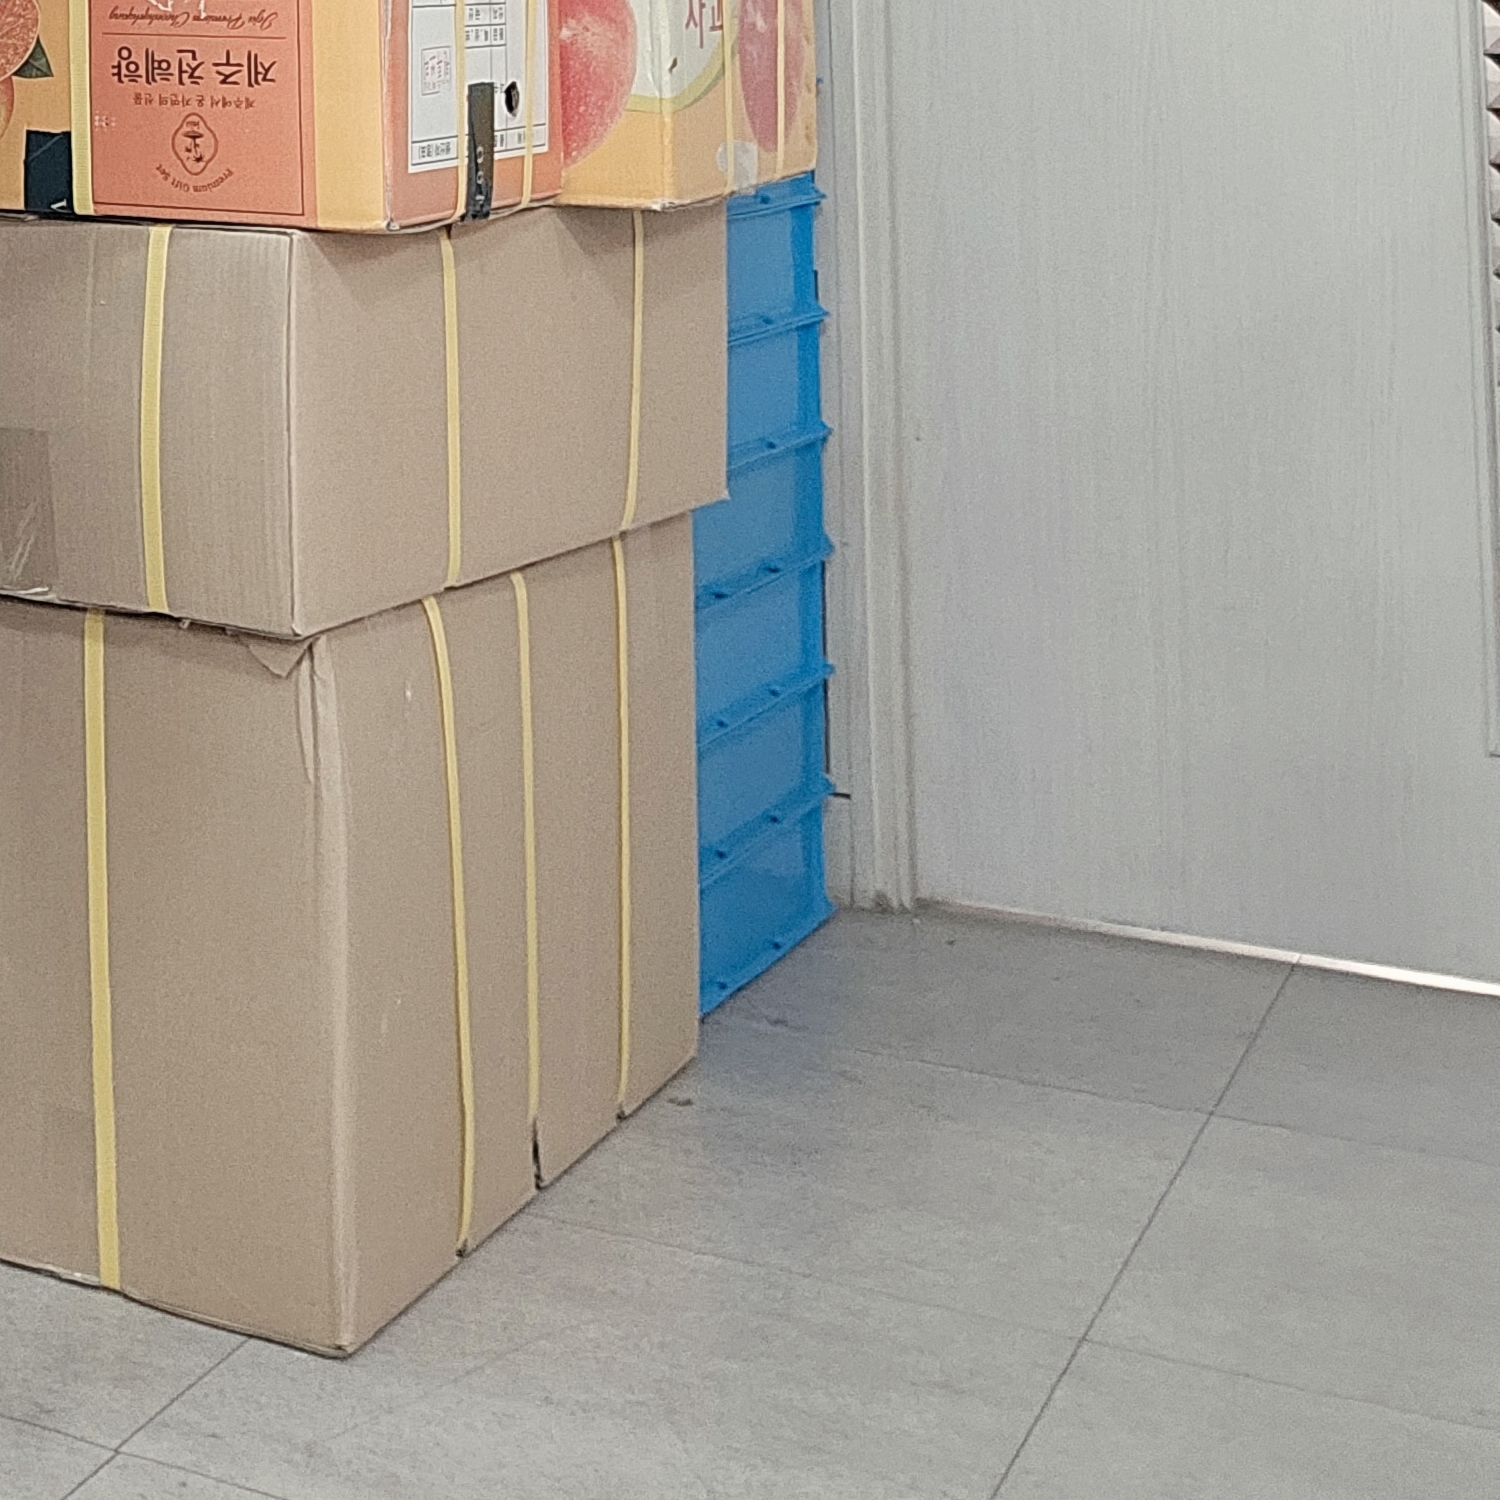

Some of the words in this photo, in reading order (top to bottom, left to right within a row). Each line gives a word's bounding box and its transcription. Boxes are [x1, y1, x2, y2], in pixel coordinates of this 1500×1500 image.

[110, 45, 205, 87] 천혜향
[211, 48, 278, 88] 제주
[158, 92, 192, 108] 자연의
[195, 93, 205, 108] 온
[209, 94, 257, 109] 제주에서
[155, 163, 171, 182] Set
[192, 167, 235, 193] Premium
[171, 177, 191, 193] Gift
